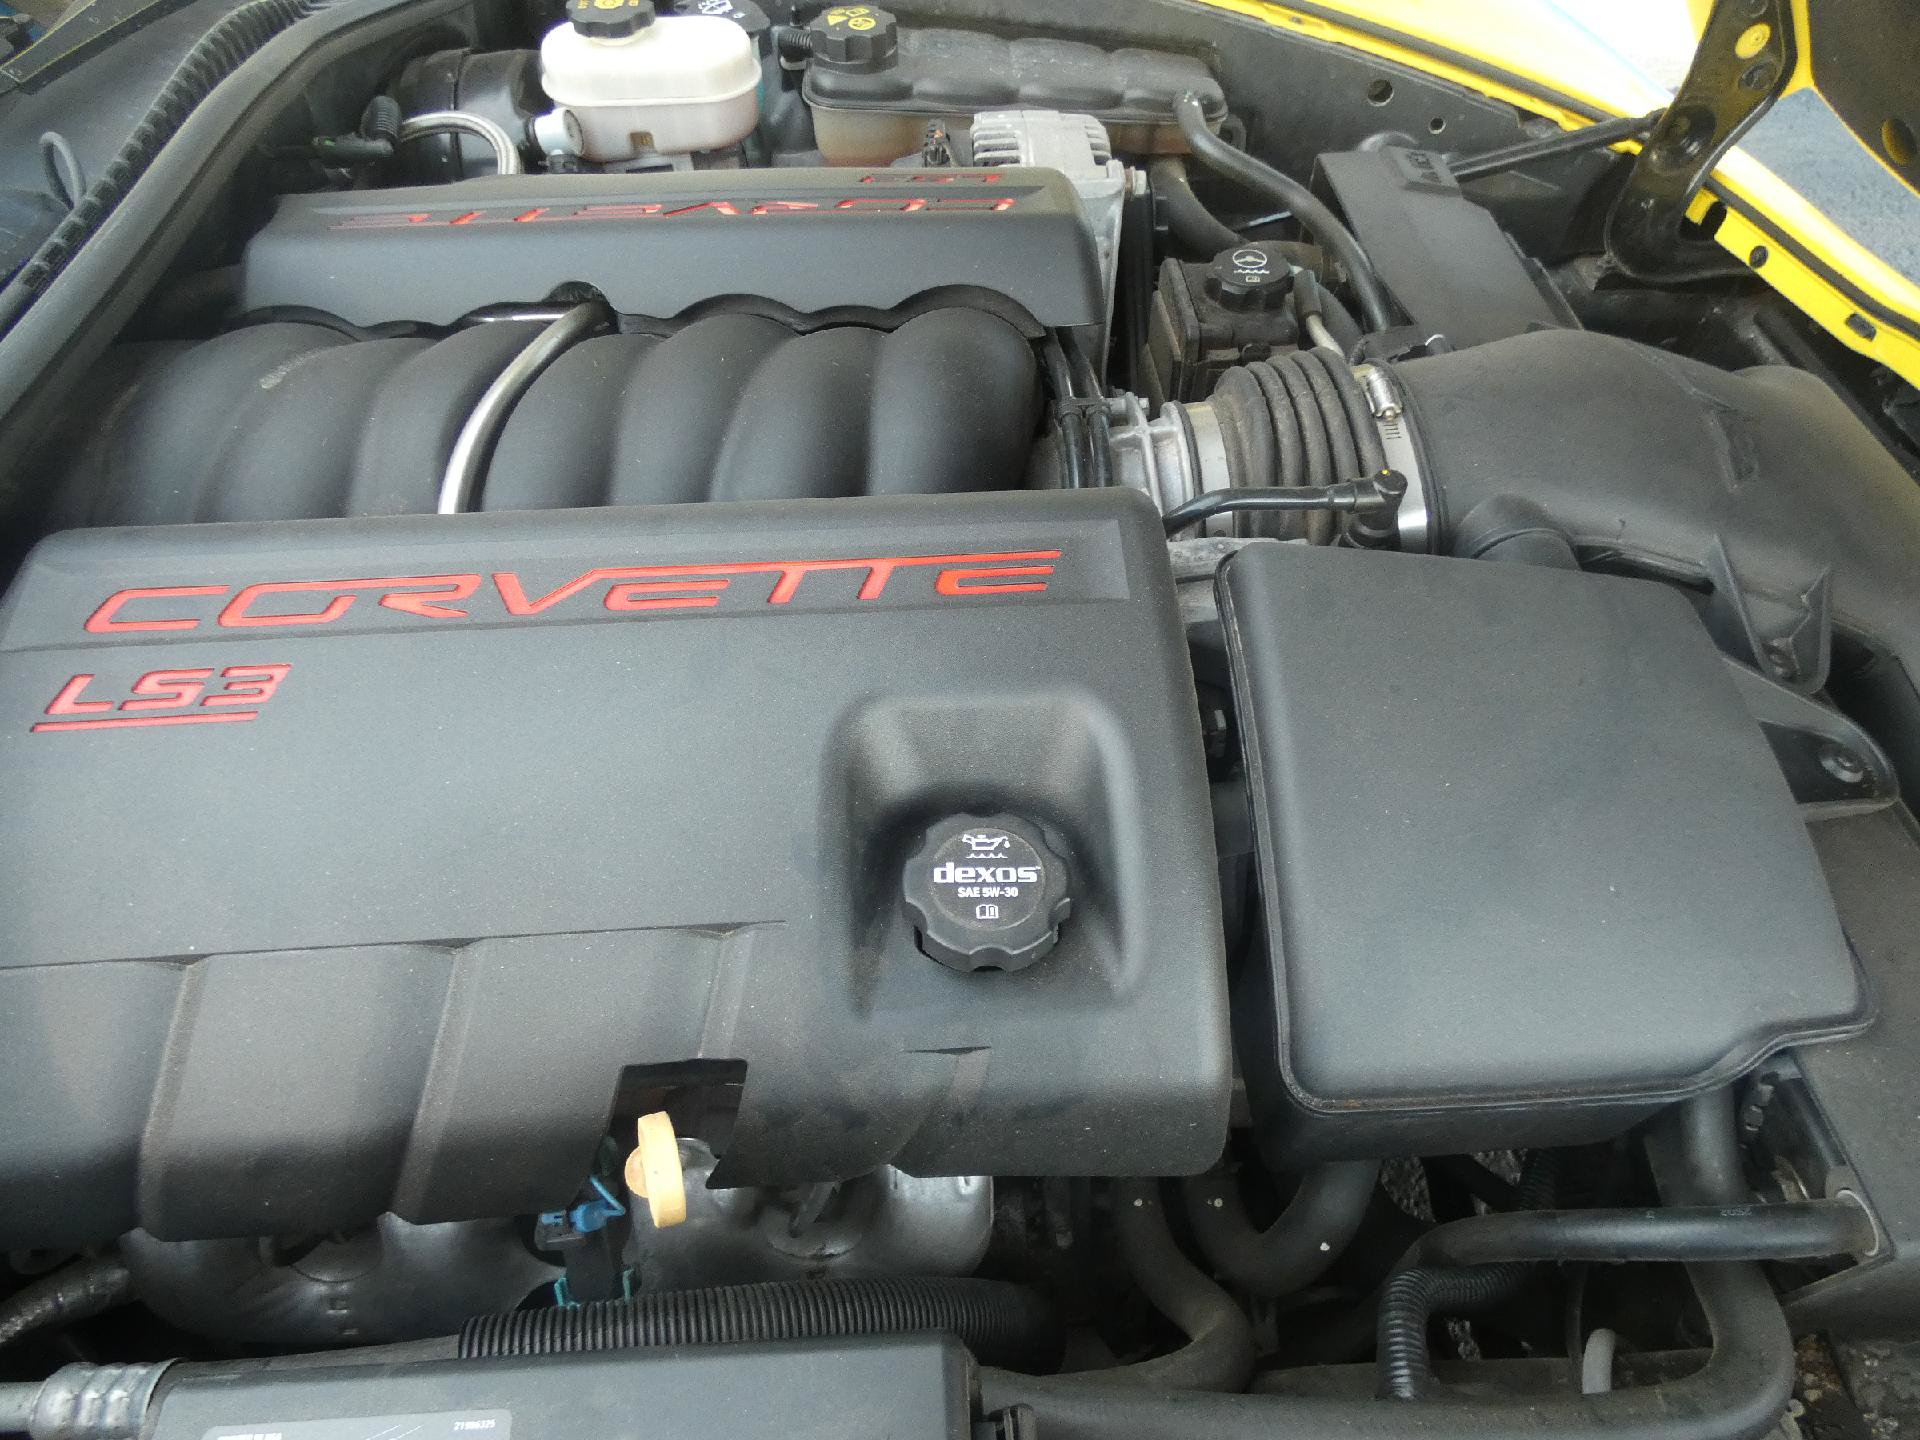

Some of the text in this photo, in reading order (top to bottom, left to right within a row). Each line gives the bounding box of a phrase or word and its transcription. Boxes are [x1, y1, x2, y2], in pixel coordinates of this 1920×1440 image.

[84, 549, 1062, 634] CORVETTE
[44, 662, 292, 716] LS3
[932, 861, 1040, 884] dexos
[957, 886, 1019, 898] SAE 5W-30
